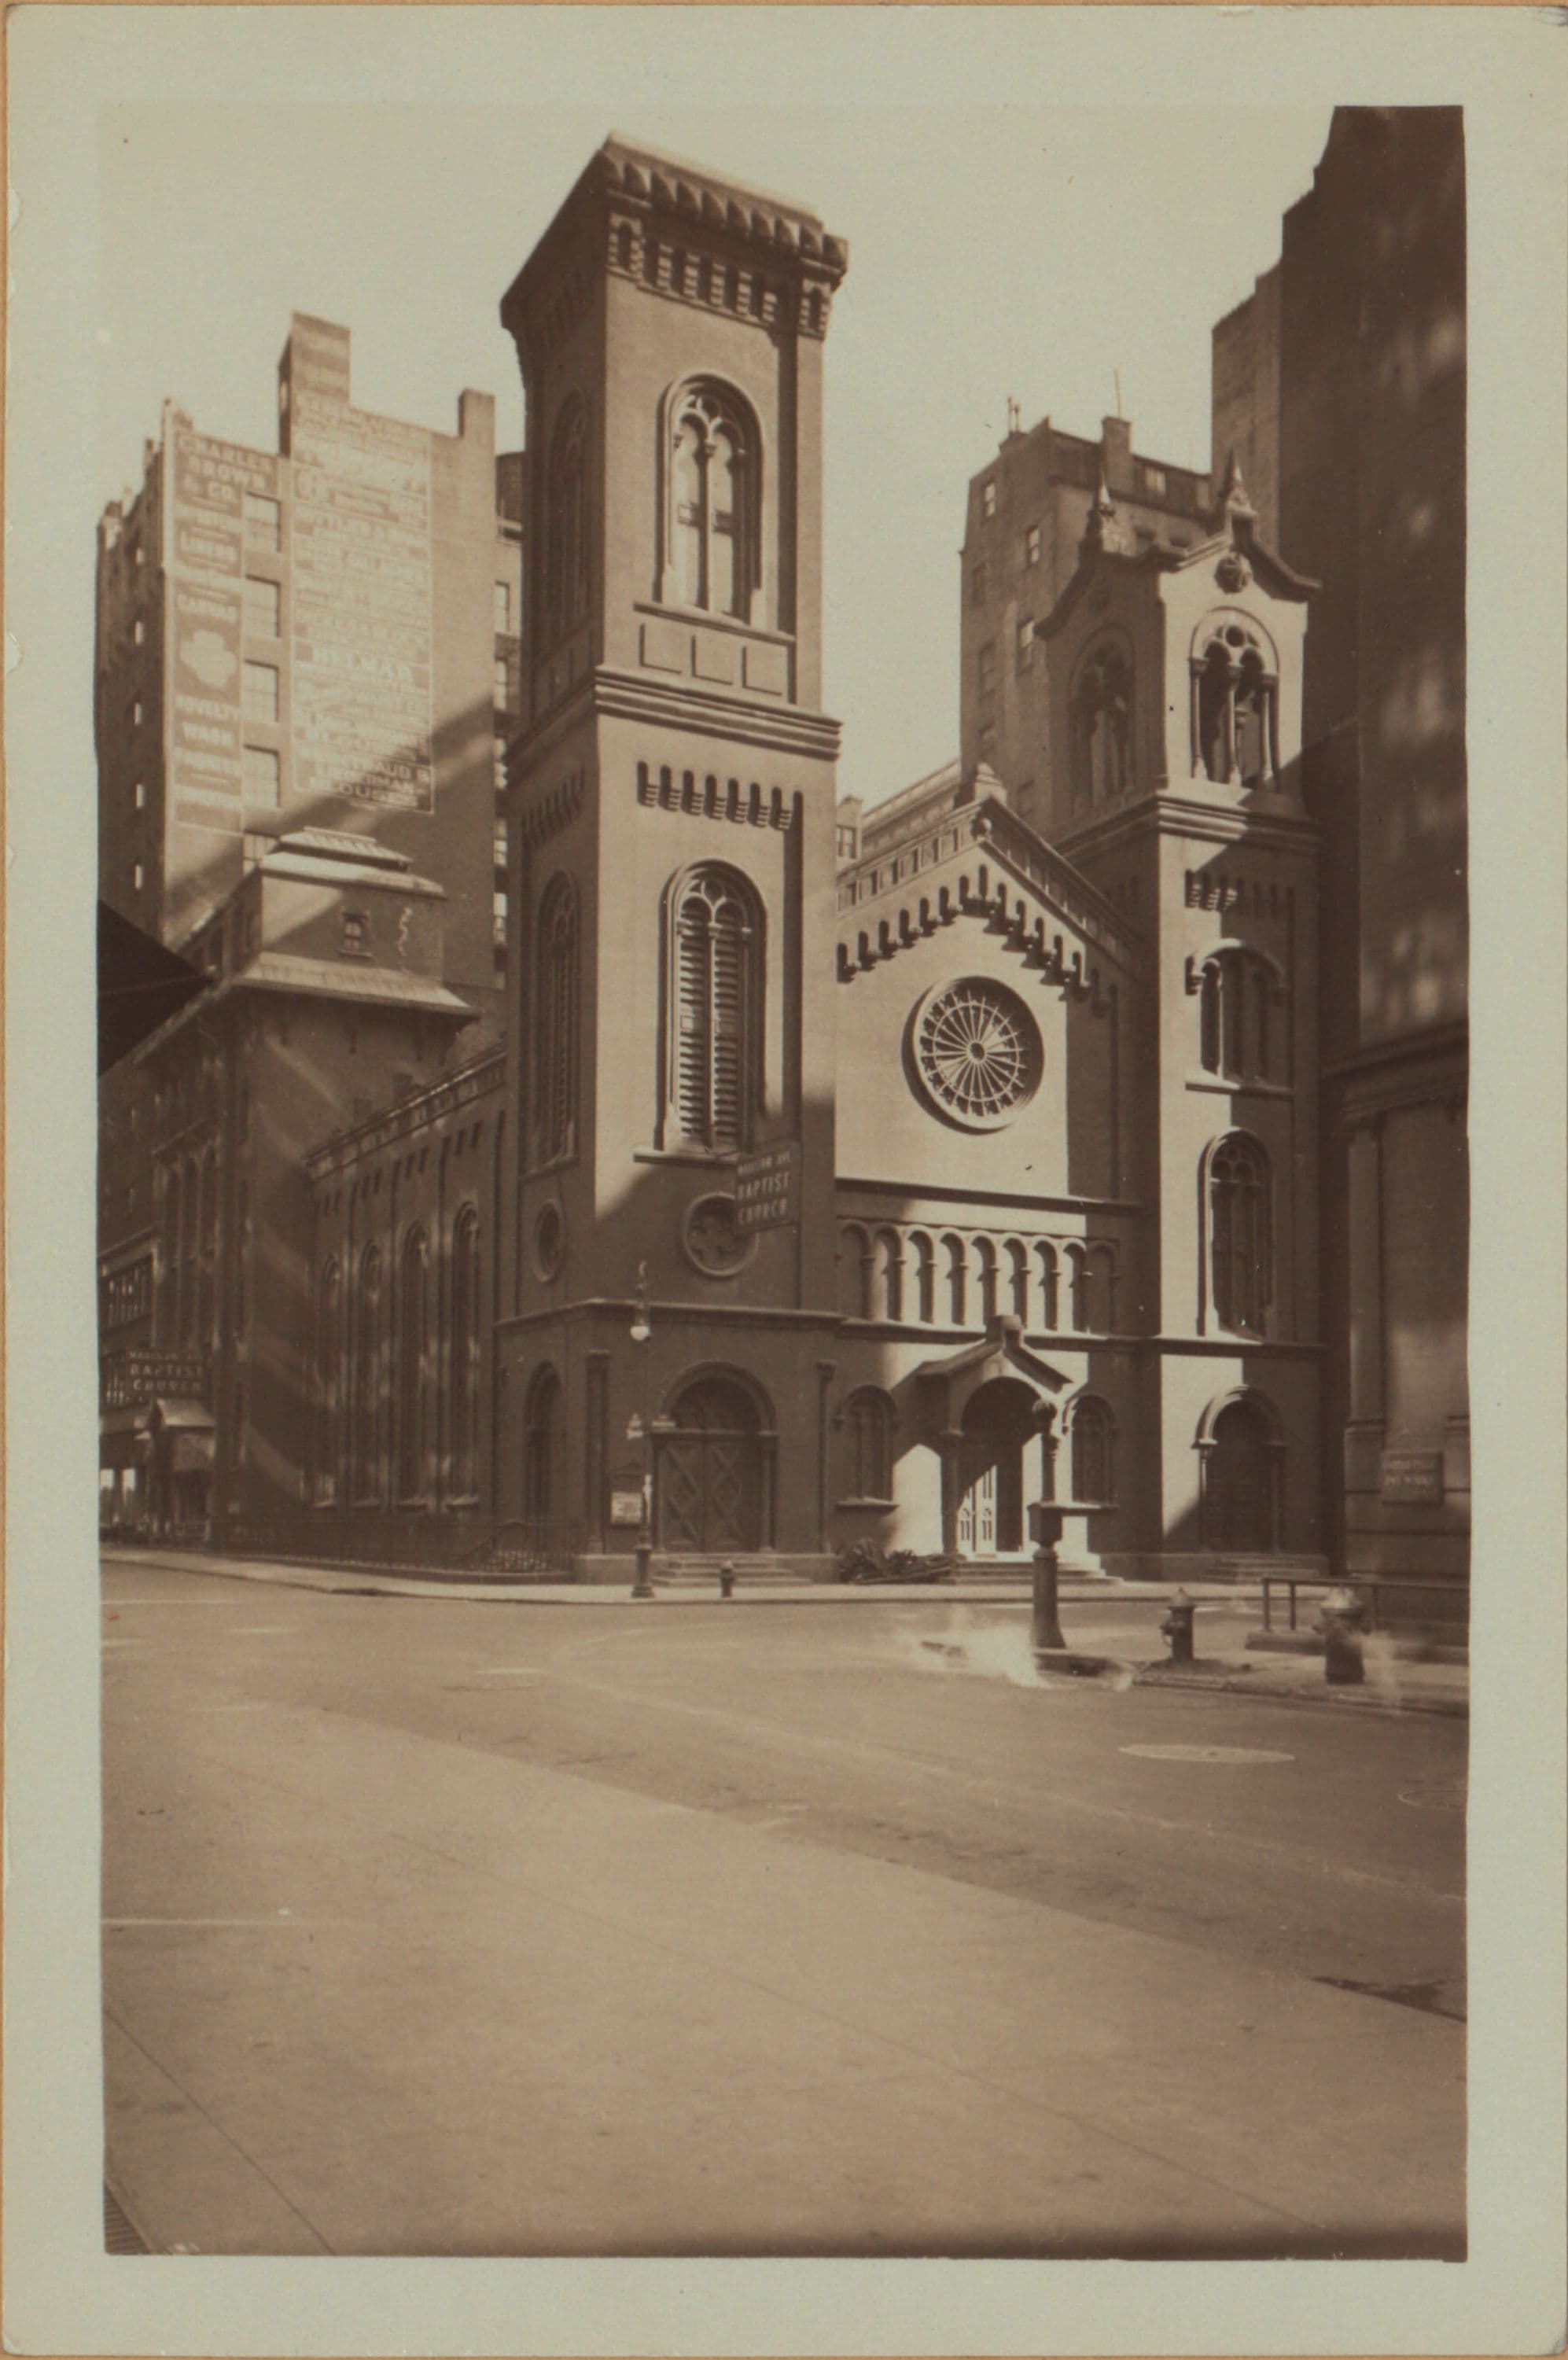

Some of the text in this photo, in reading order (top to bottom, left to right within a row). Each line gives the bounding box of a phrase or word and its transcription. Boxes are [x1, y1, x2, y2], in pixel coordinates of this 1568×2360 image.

[738, 1171, 790, 1202] BAPTIST
[738, 1198, 787, 1227] CHURCH
[130, 1363, 203, 1378] BAPTIST
[133, 1378, 202, 1392] CHURCH
